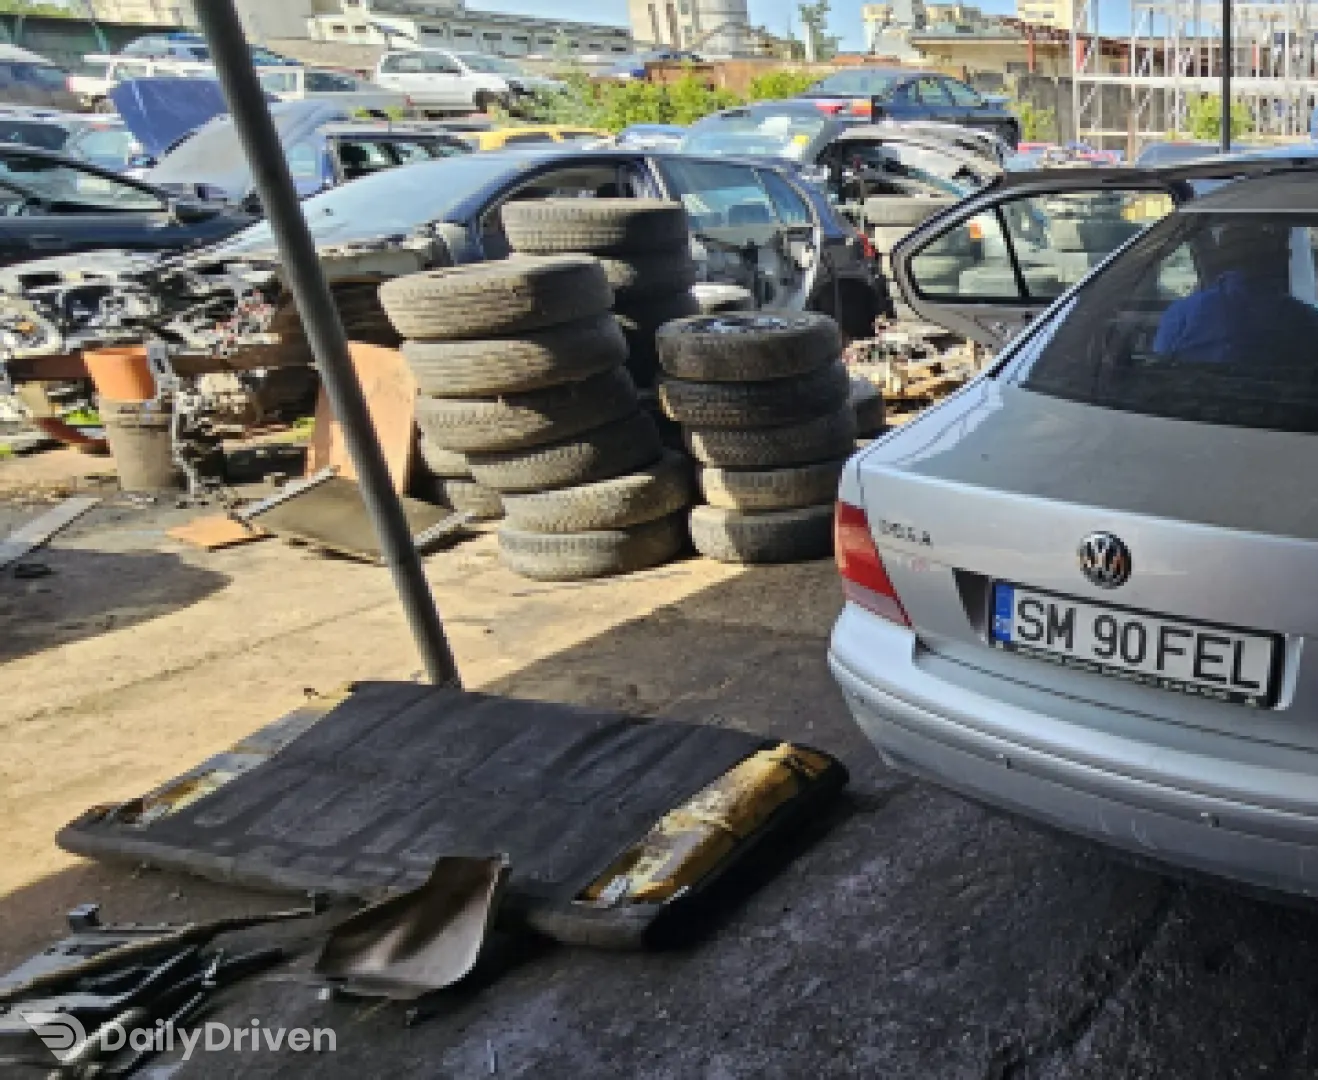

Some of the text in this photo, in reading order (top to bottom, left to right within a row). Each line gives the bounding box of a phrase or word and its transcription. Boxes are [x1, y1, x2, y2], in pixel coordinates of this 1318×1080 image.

[1017, 597, 1076, 651] SM
[1092, 614, 1146, 665] 90
[1156, 625, 1260, 688] FEL
